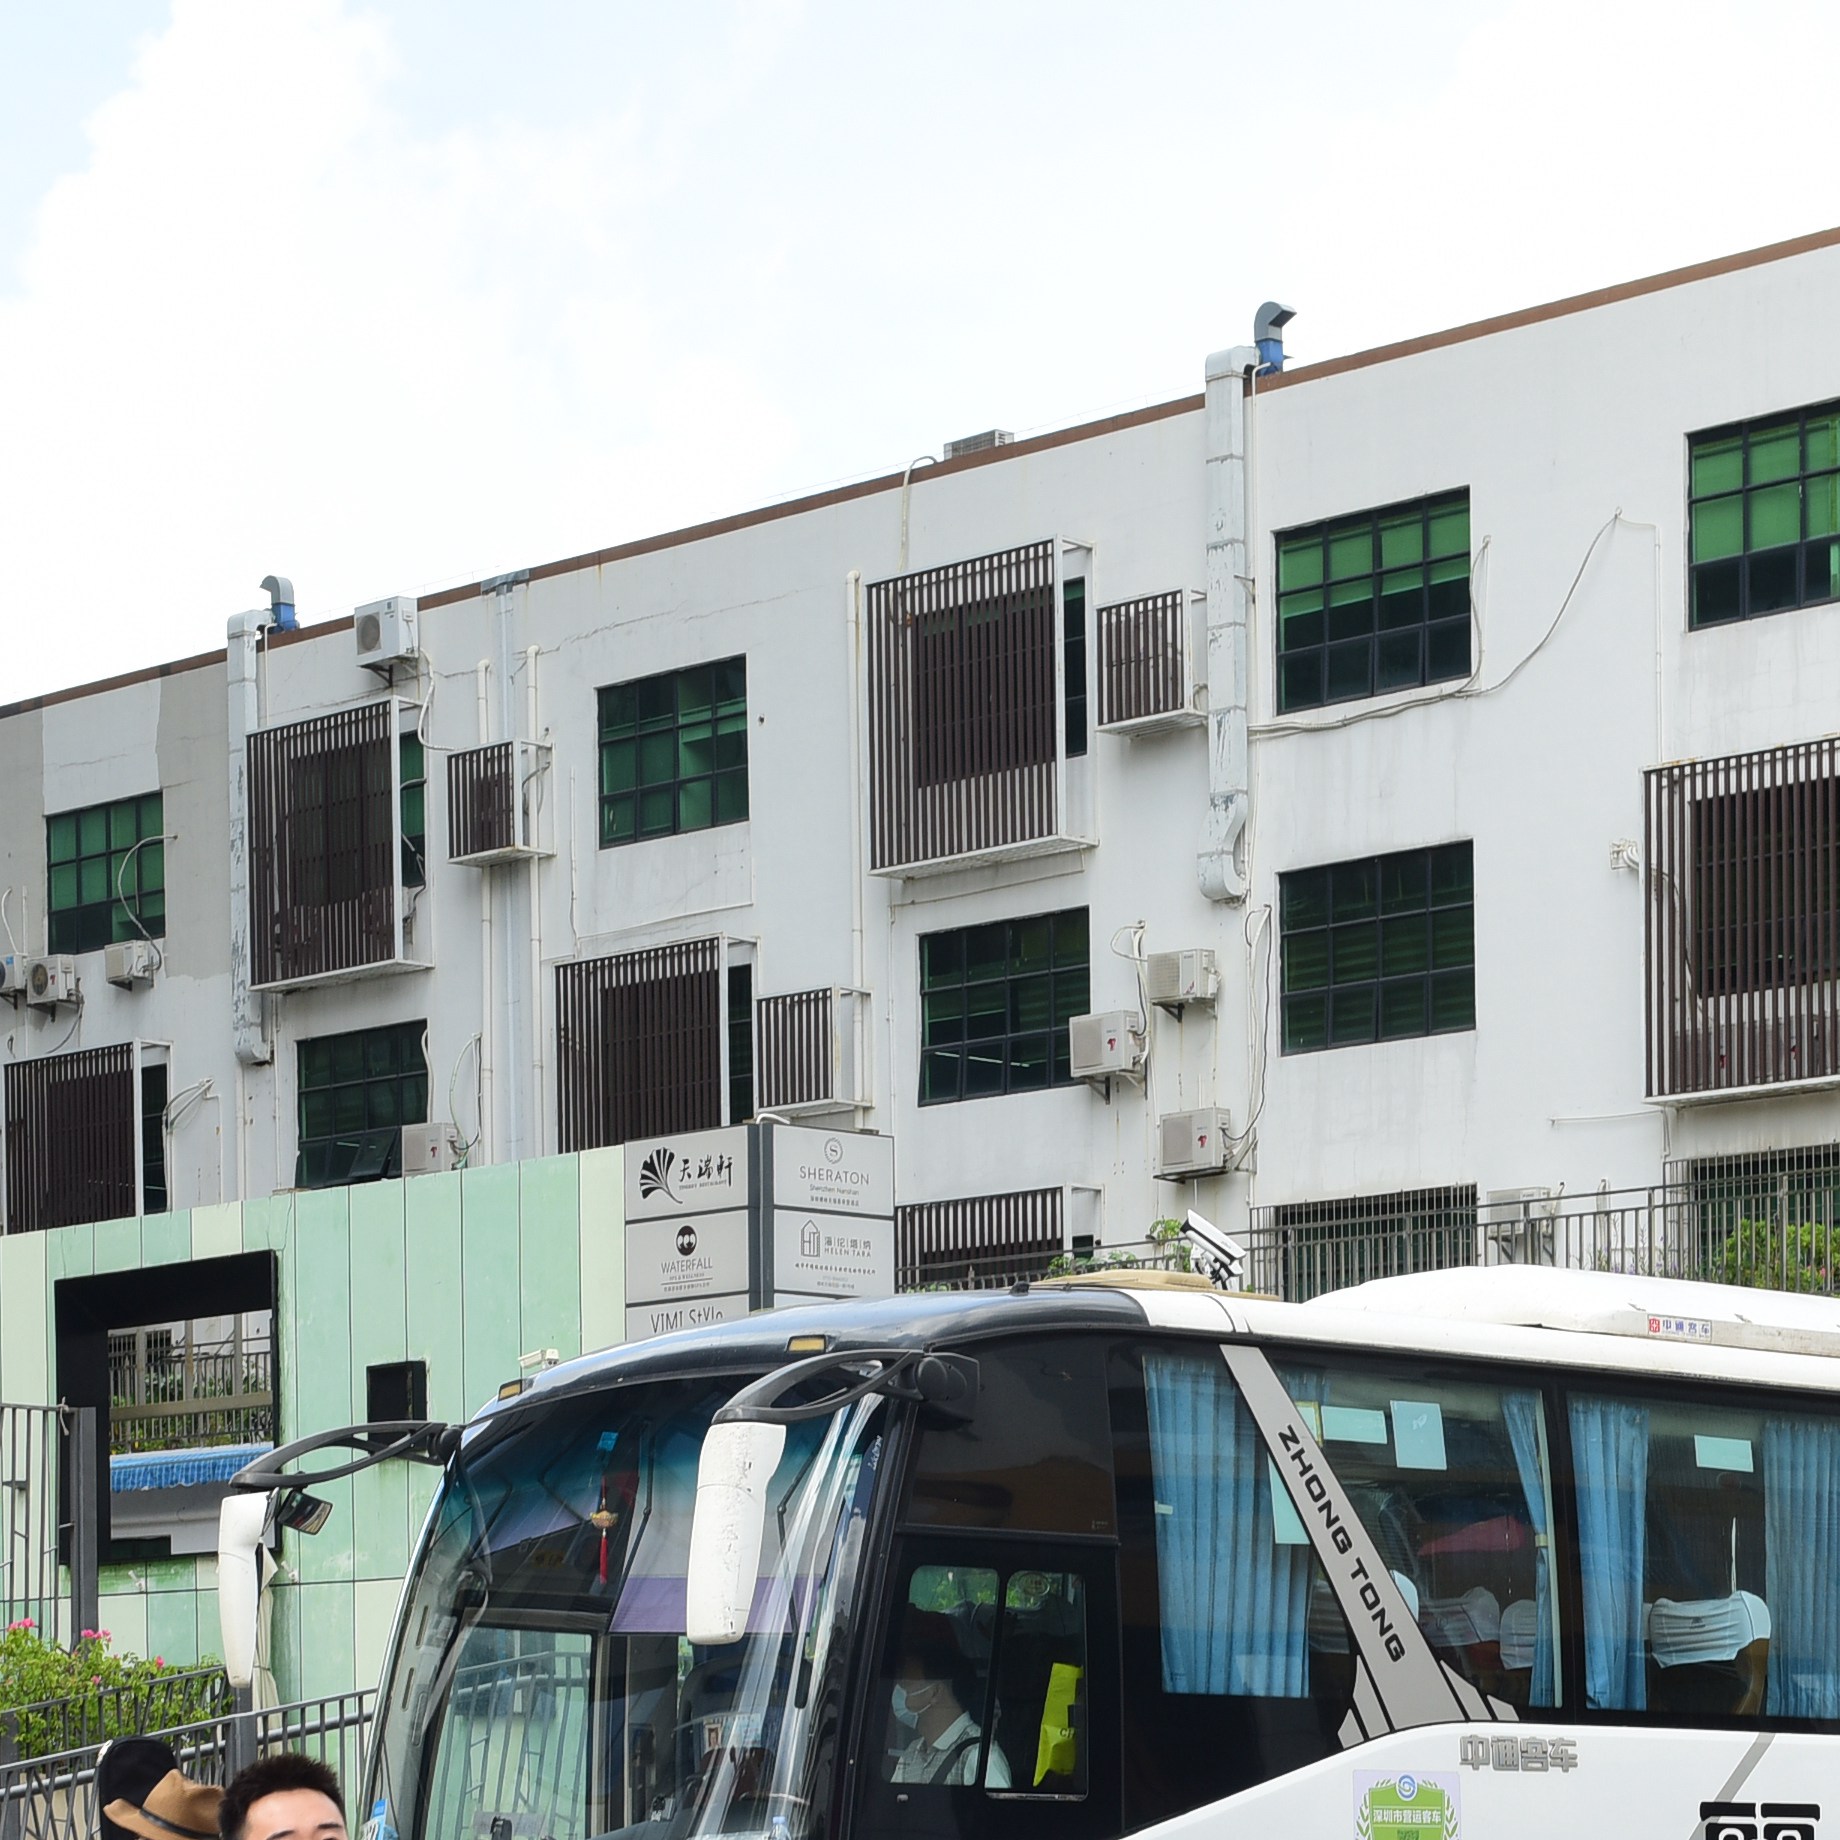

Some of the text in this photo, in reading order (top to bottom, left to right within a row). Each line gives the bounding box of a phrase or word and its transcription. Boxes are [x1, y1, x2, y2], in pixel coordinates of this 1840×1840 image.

[800, 1166, 869, 1185] SHERATON
[810, 1184, 859, 1196] Shenzhen Nanshan
[825, 1247, 871, 1258] HELEN TARA
[661, 1257, 713, 1274] WATERFALL
[651, 1311, 683, 1334] VIMI
[1278, 1424, 1406, 1663] ZHONG TONG
[1459, 1734, 1578, 1772] 中通客车
[1372, 1808, 1442, 1825] 深圳市营运客车
